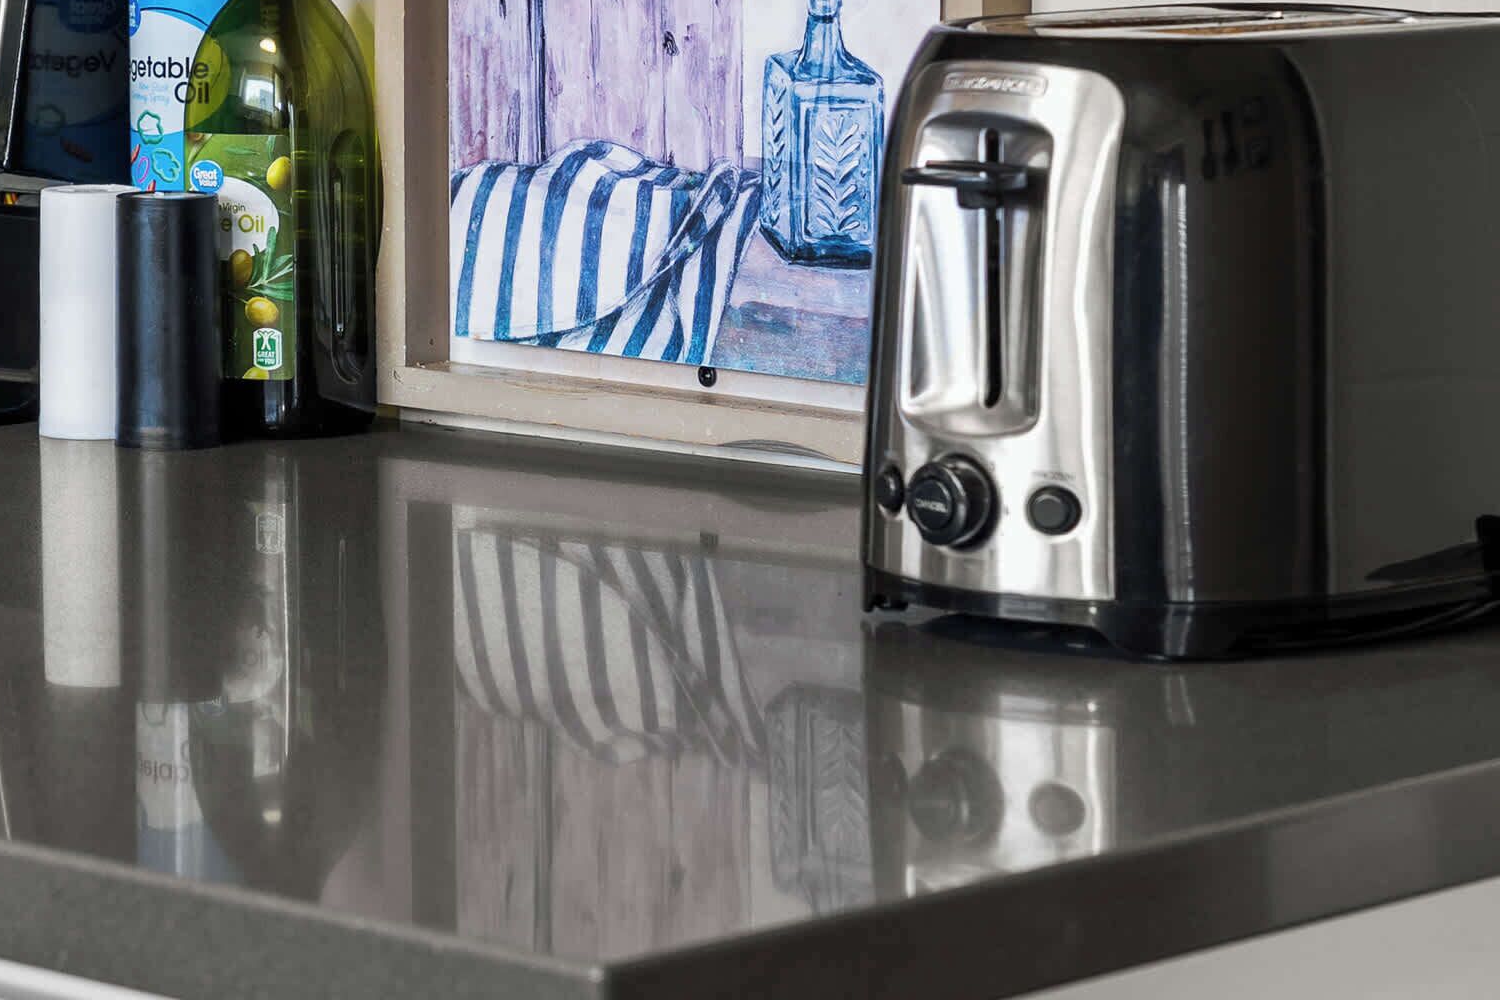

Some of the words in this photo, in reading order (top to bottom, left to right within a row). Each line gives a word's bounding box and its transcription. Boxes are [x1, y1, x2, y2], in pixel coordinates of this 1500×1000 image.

[129, 55, 210, 82] getable
[174, 81, 210, 105] Oil
[193, 167, 218, 181] Great
[199, 180, 218, 188] Value
[222, 202, 246, 214] Virgin
[238, 214, 265, 233] Oil
